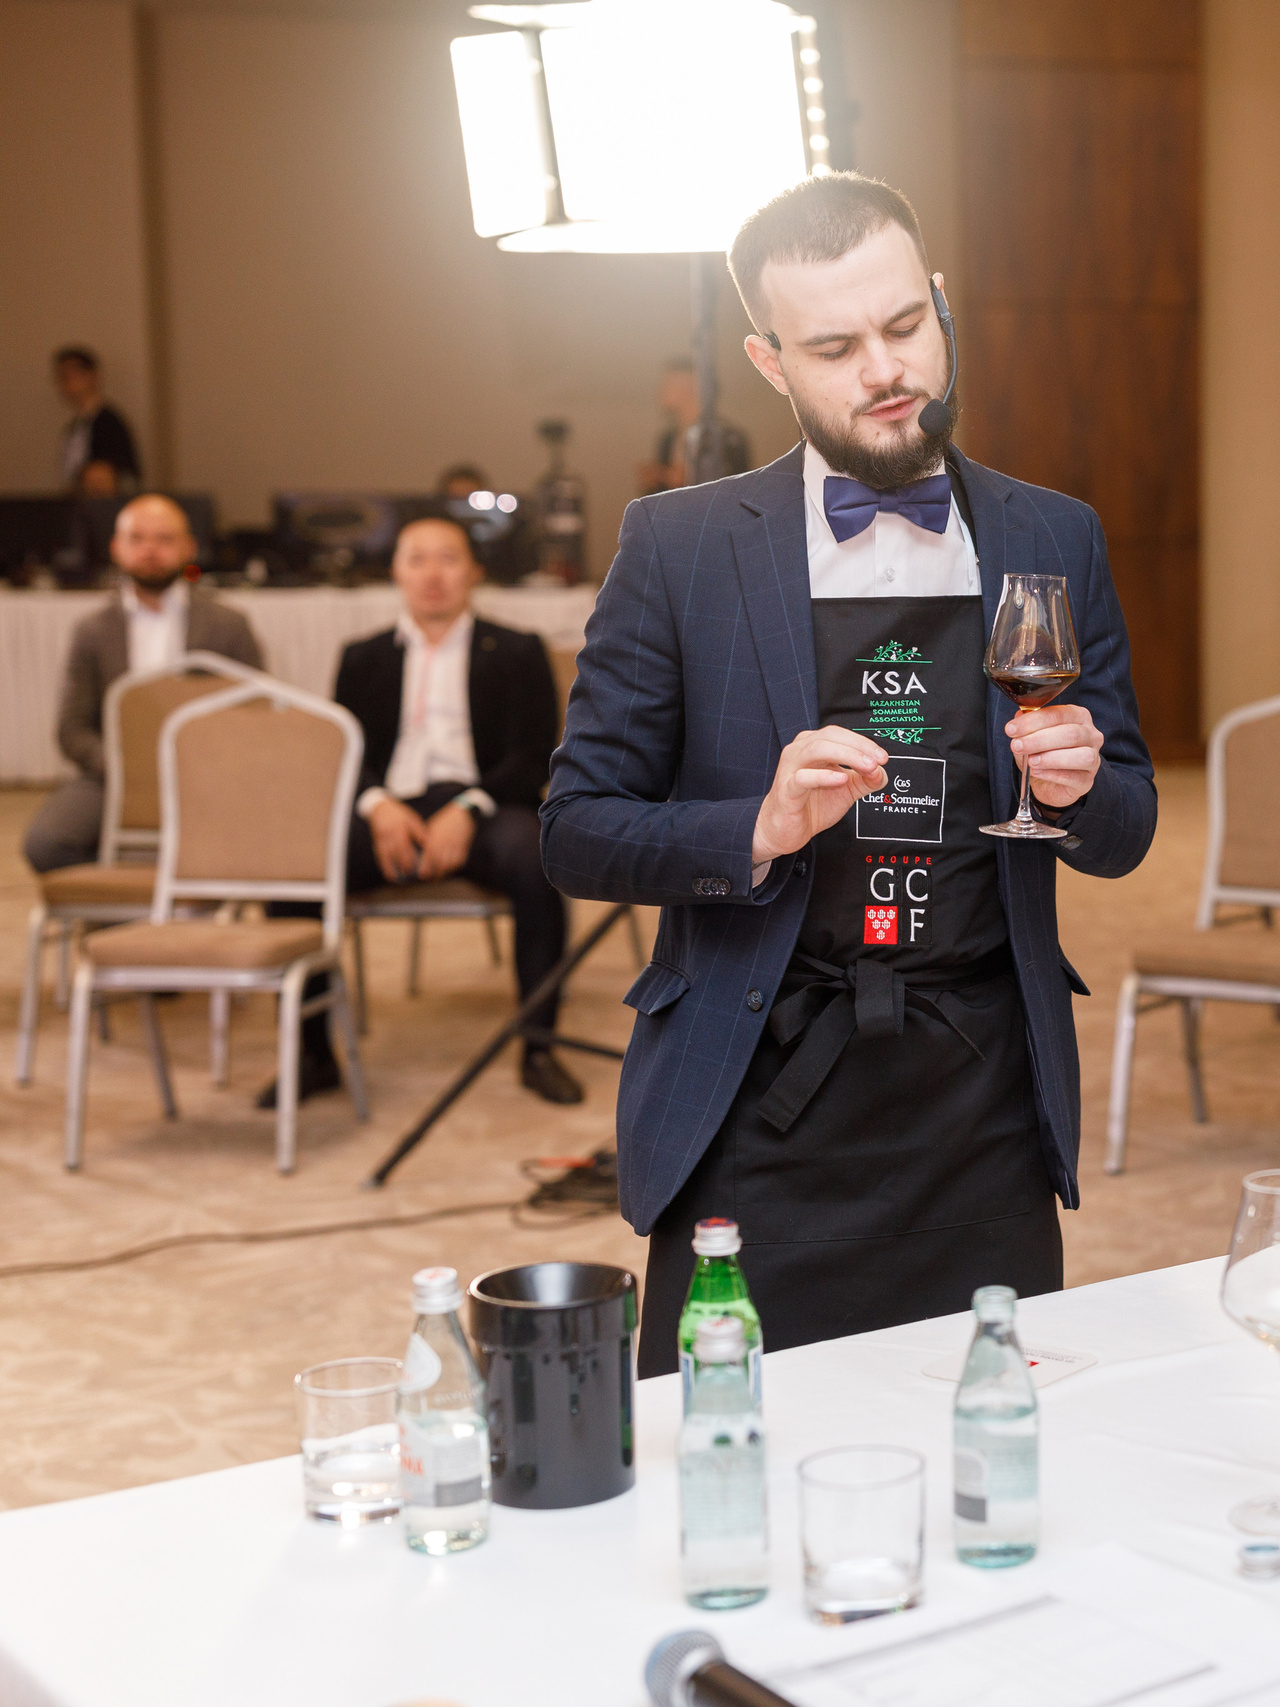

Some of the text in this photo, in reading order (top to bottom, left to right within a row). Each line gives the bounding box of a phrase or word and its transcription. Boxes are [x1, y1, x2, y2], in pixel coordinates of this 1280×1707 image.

[861, 670, 928, 695] KSA
[869, 699, 921, 707] KAZAKHSTAN
[883, 805, 919, 814] FRANCE
[865, 855, 932, 865] GROUPE
